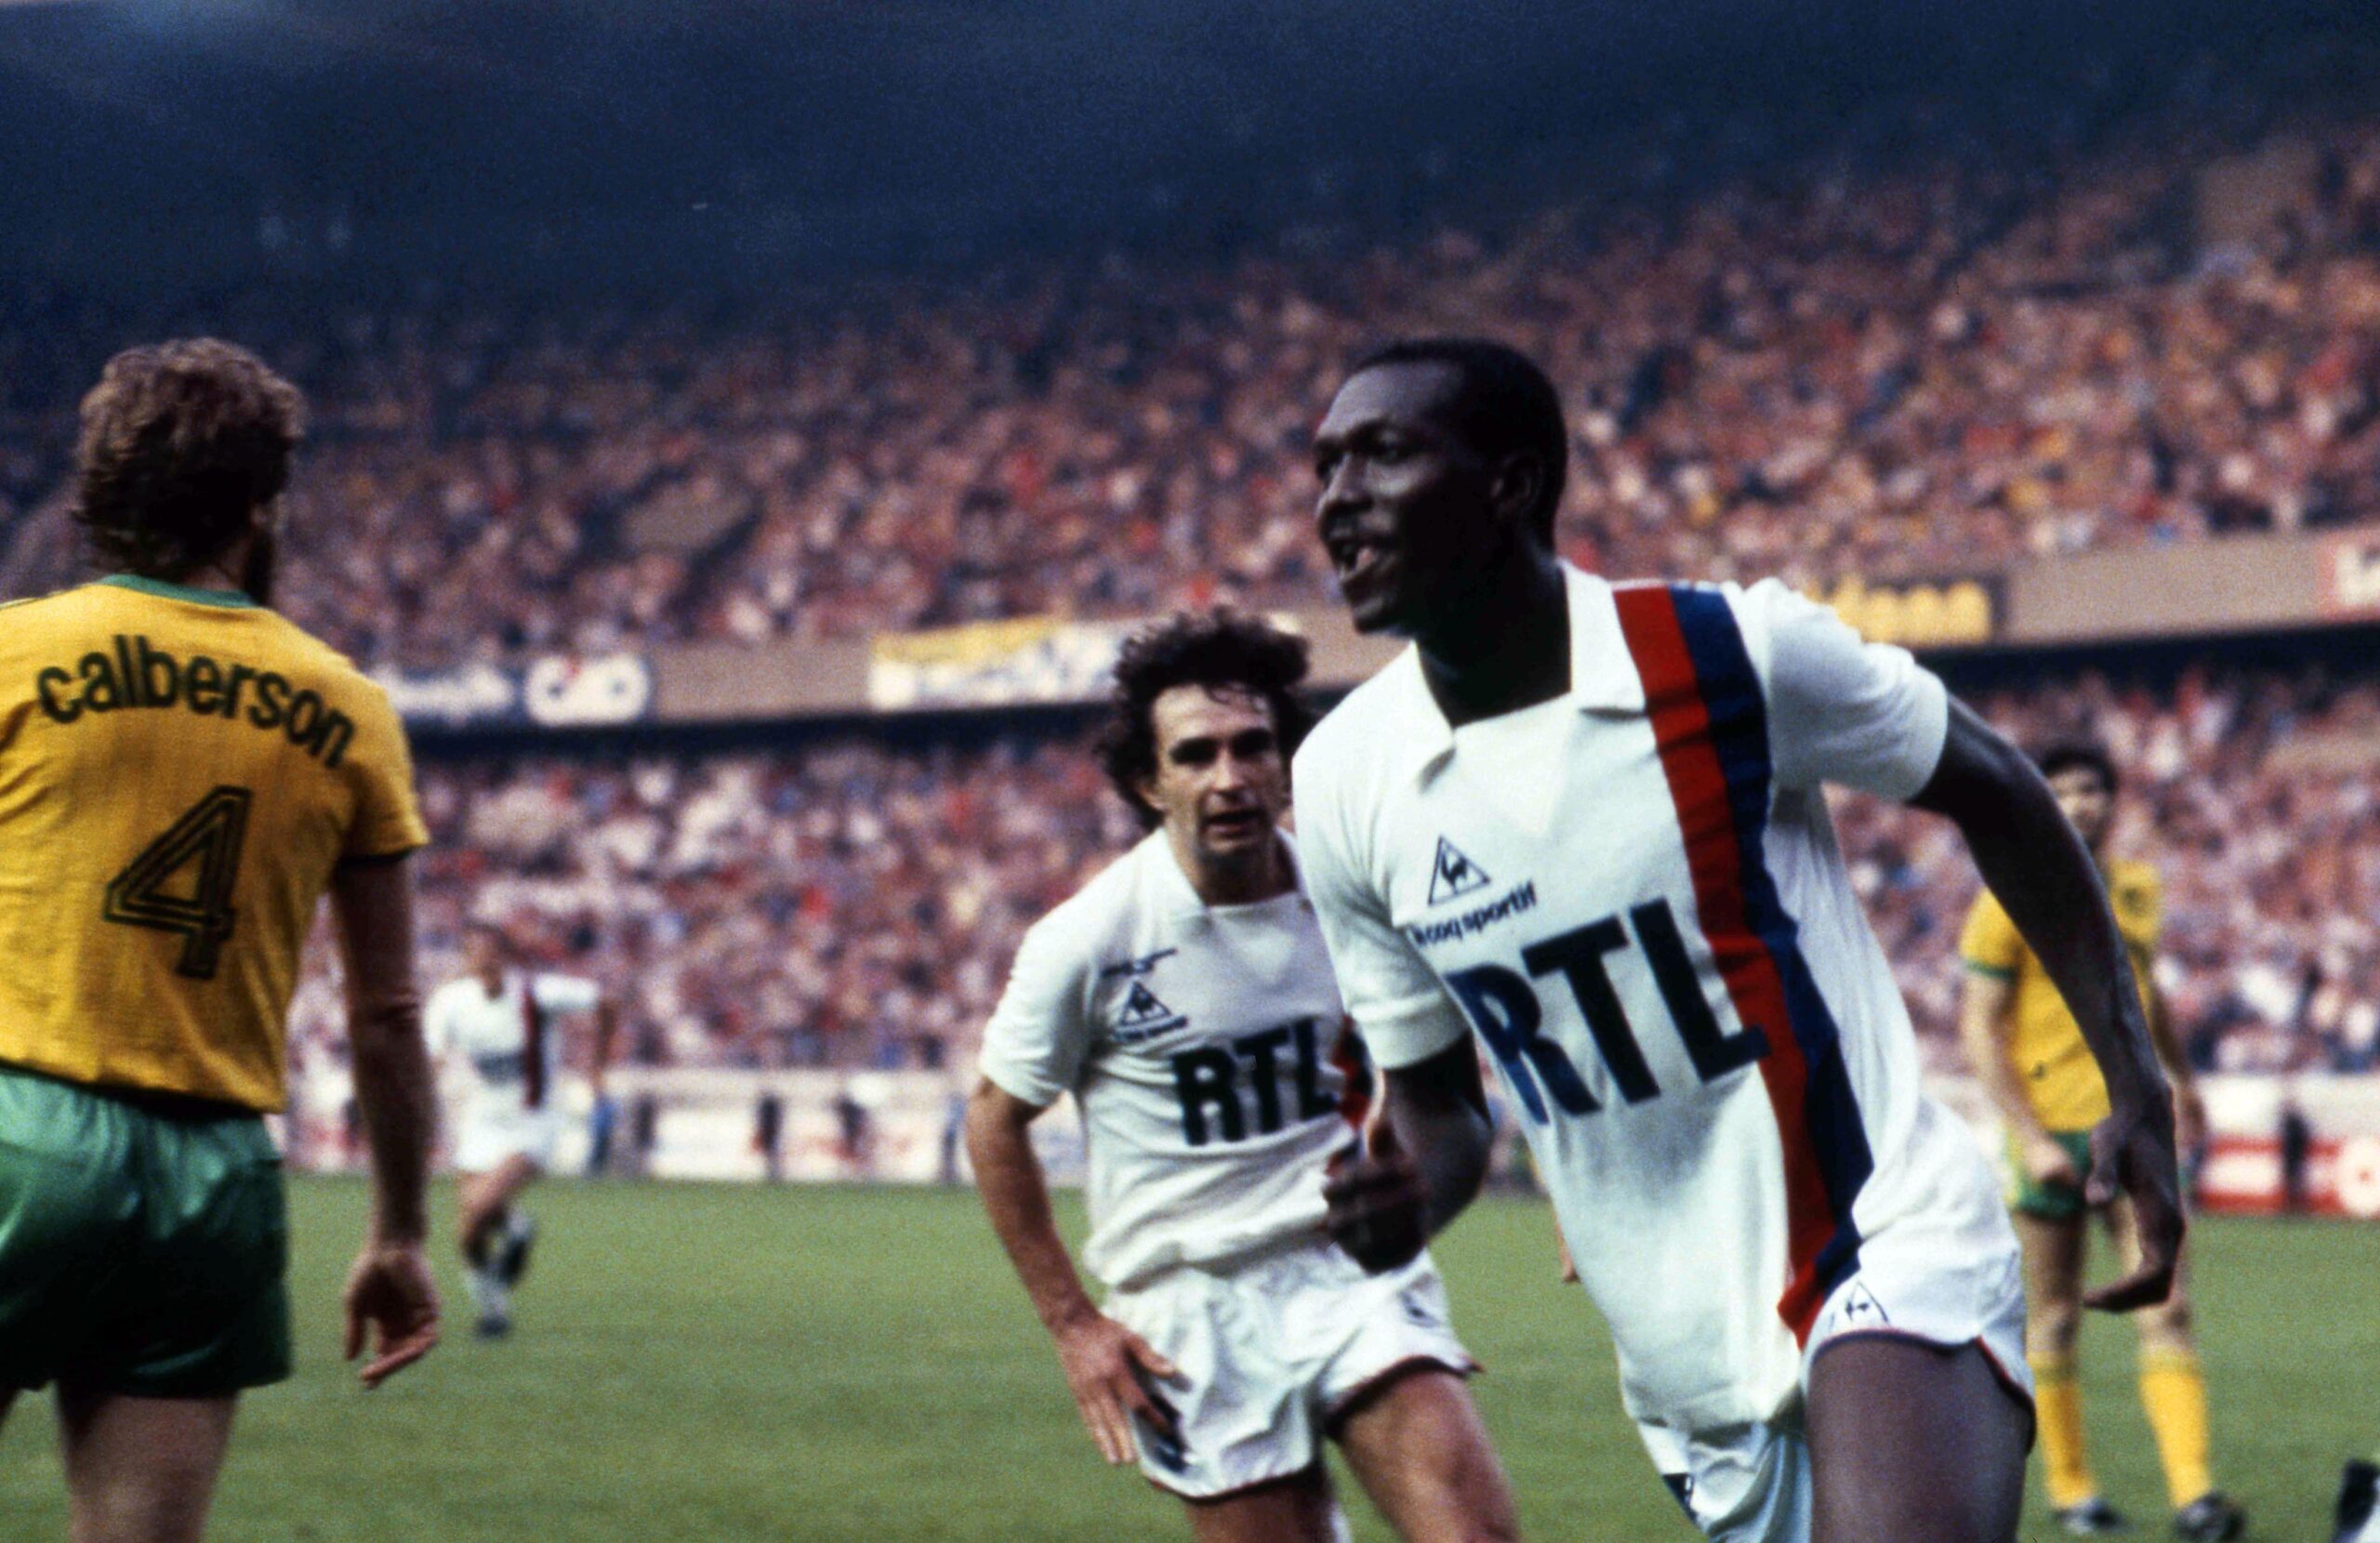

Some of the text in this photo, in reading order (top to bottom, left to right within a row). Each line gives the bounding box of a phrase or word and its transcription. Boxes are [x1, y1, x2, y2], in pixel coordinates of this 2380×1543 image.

[37, 634, 354, 768] calberson
[101, 784, 251, 980] 4
[1172, 1015, 1339, 1146] RTL
[1447, 897, 1771, 1125] RTL
